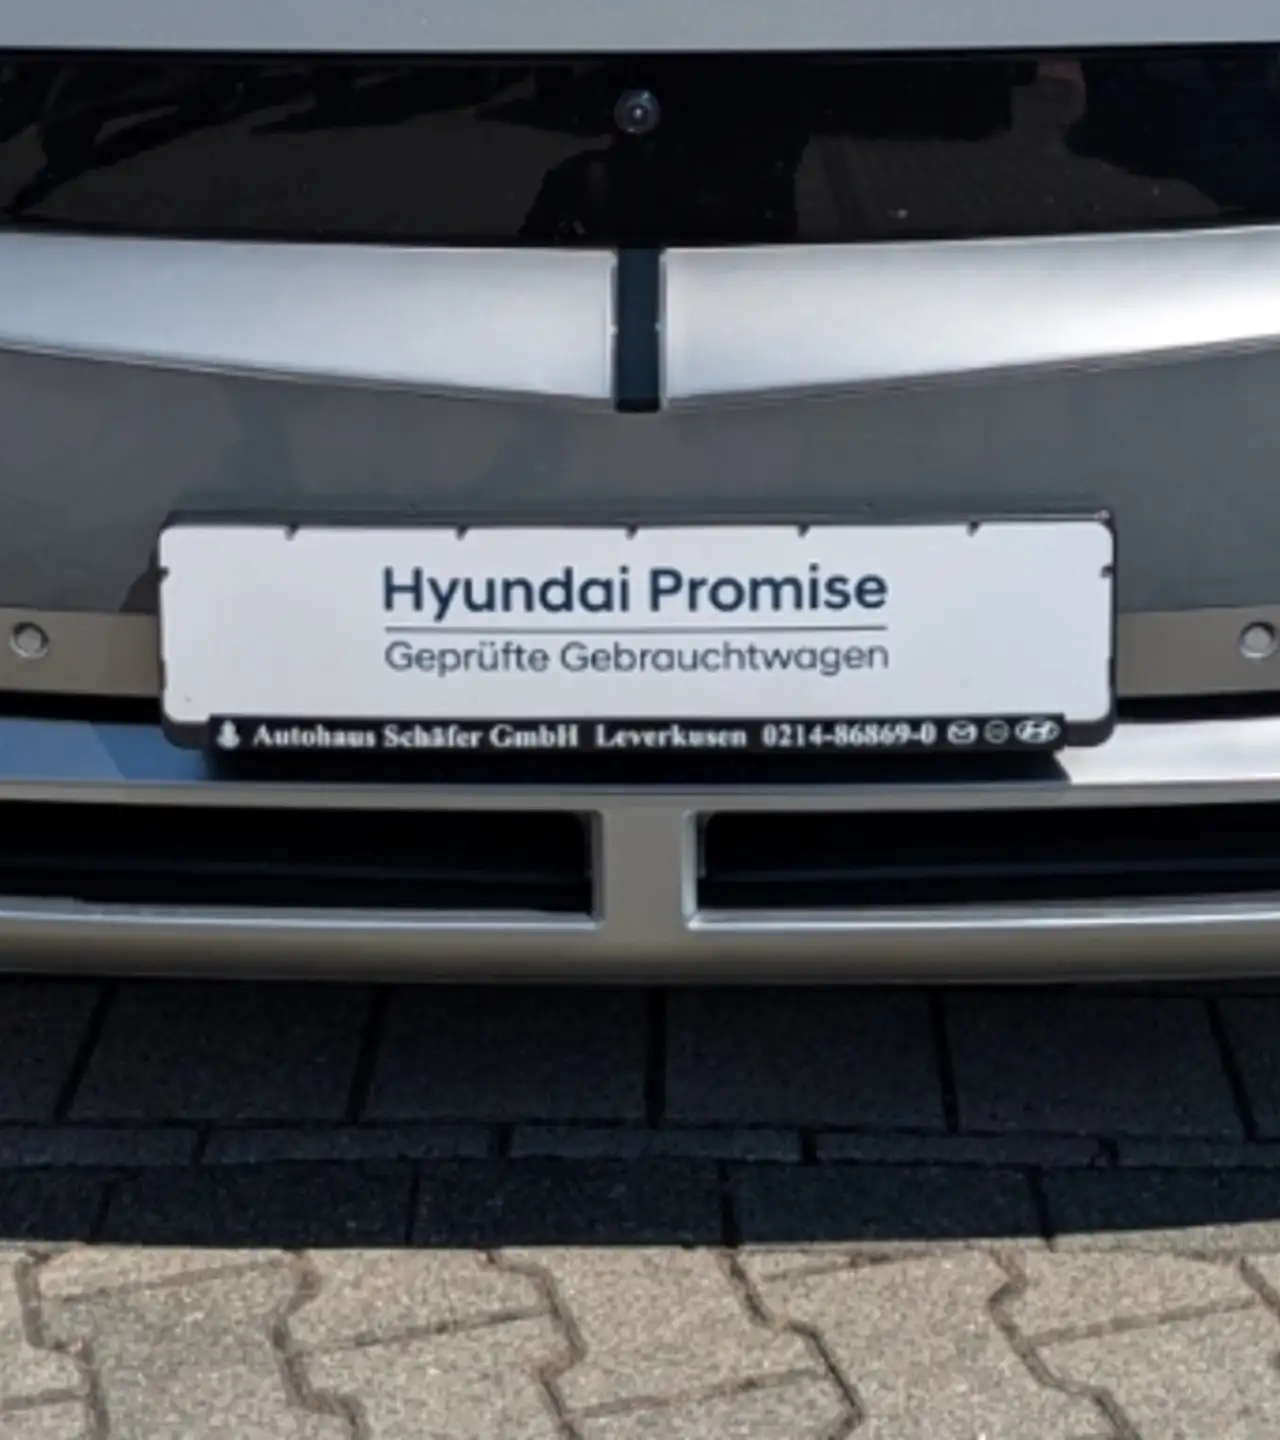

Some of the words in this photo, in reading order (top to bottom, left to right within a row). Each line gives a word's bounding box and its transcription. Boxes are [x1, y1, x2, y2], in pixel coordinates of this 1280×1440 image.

[383, 565, 630, 622] Hyundai
[649, 563, 889, 612] Promise
[383, 640, 550, 677] Geprüfte
[560, 640, 889, 676] Gebrauchtwagen
[252, 724, 376, 748] Autohaus
[382, 724, 483, 748] Schäfer
[488, 724, 580, 749] GmbH
[594, 724, 748, 748] Leverkusen
[762, 722, 937, 748] 0214-86869-0
